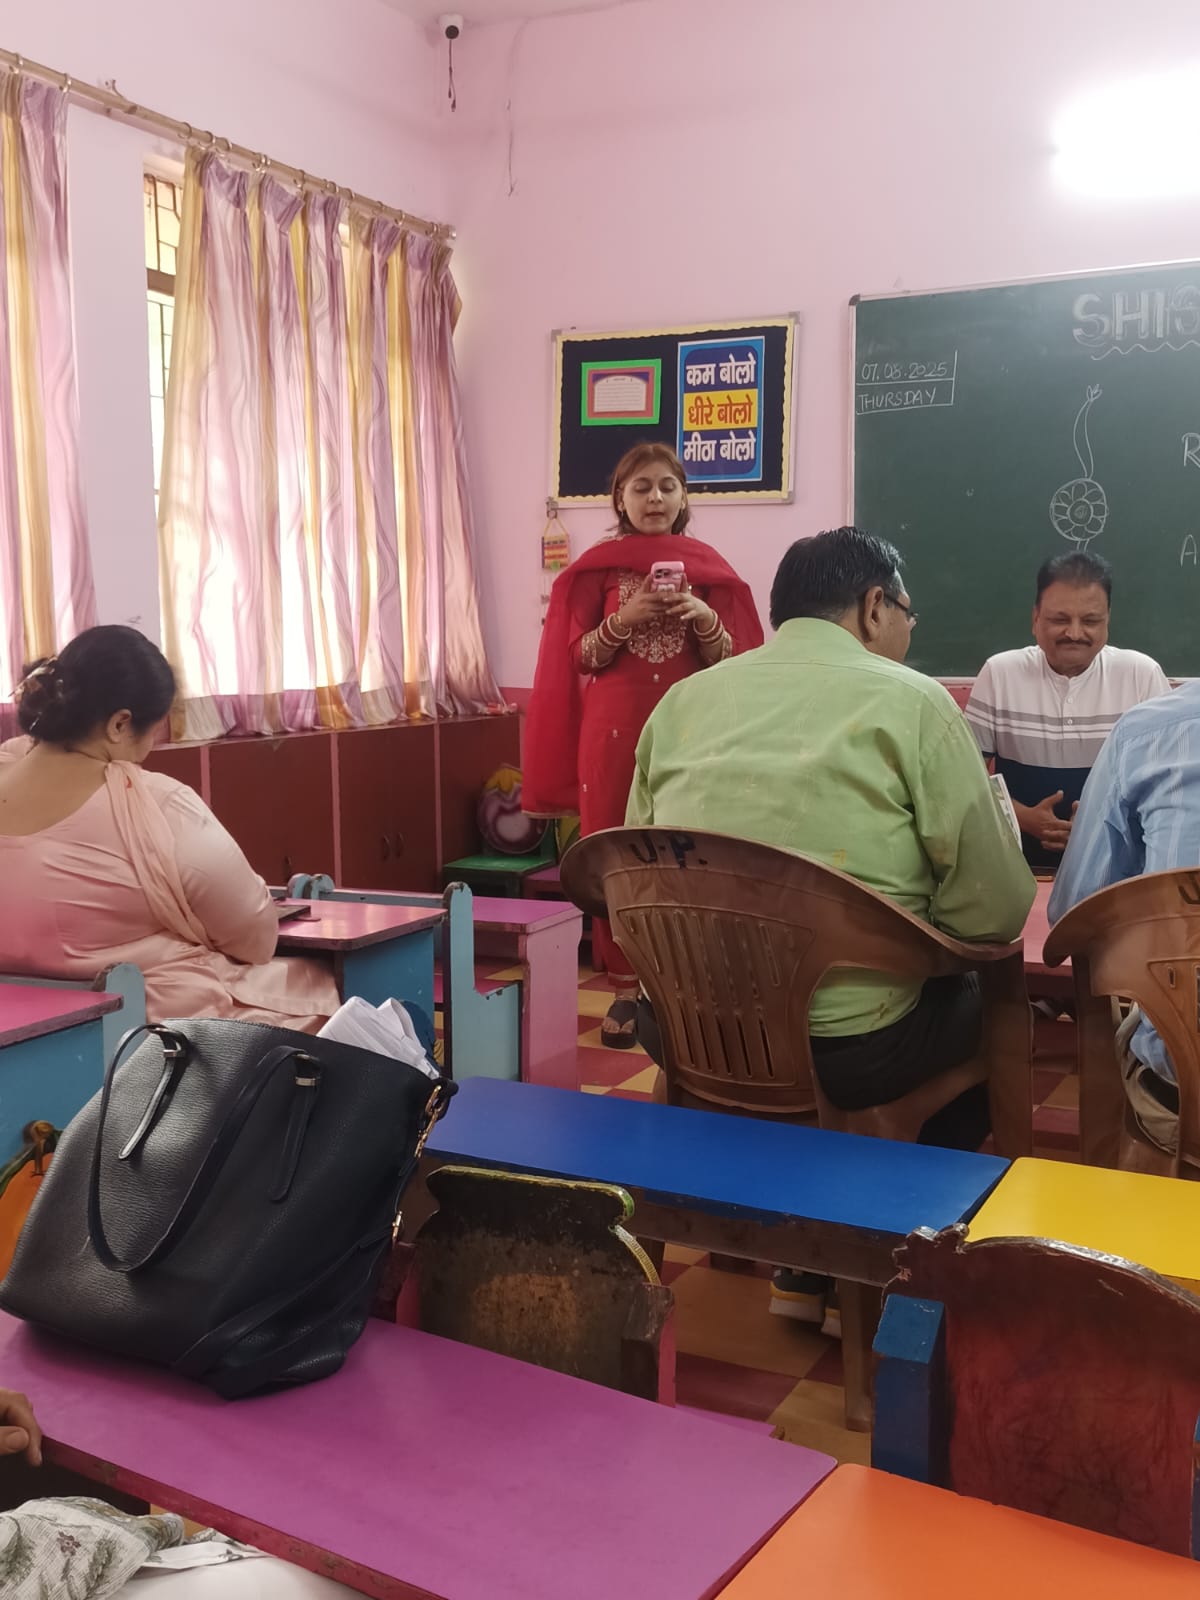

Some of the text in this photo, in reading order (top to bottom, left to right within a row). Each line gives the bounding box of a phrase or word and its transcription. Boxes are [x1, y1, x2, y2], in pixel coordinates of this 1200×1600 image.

[686, 352, 757, 386] कम बोलो
[688, 393, 753, 425] धीरे बोलो
[858, 387, 936, 412] THURSDAY
[683, 429, 757, 462] मीठा बोलो
